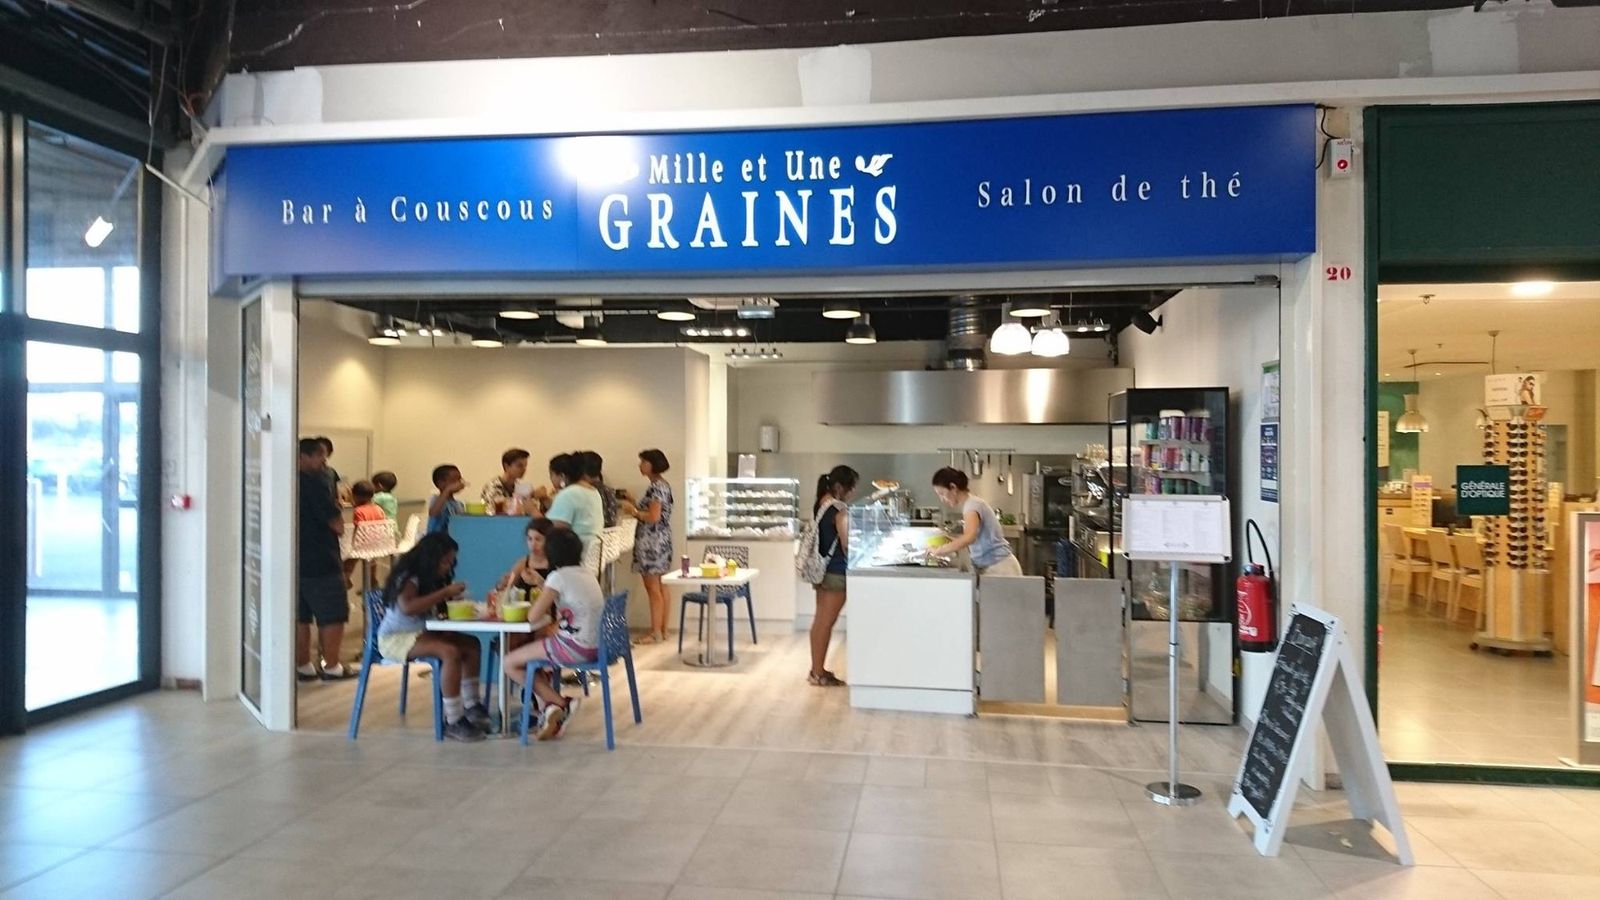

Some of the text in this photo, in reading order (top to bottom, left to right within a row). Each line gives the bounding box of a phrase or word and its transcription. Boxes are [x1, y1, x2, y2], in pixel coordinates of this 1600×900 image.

[649, 150, 841, 185] Mille et Une
[977, 170, 1243, 208] Salon de thé
[281, 196, 554, 225] Bar à Couscous
[598, 184, 898, 251] GRAINES
[1326, 266, 1352, 281] 20
